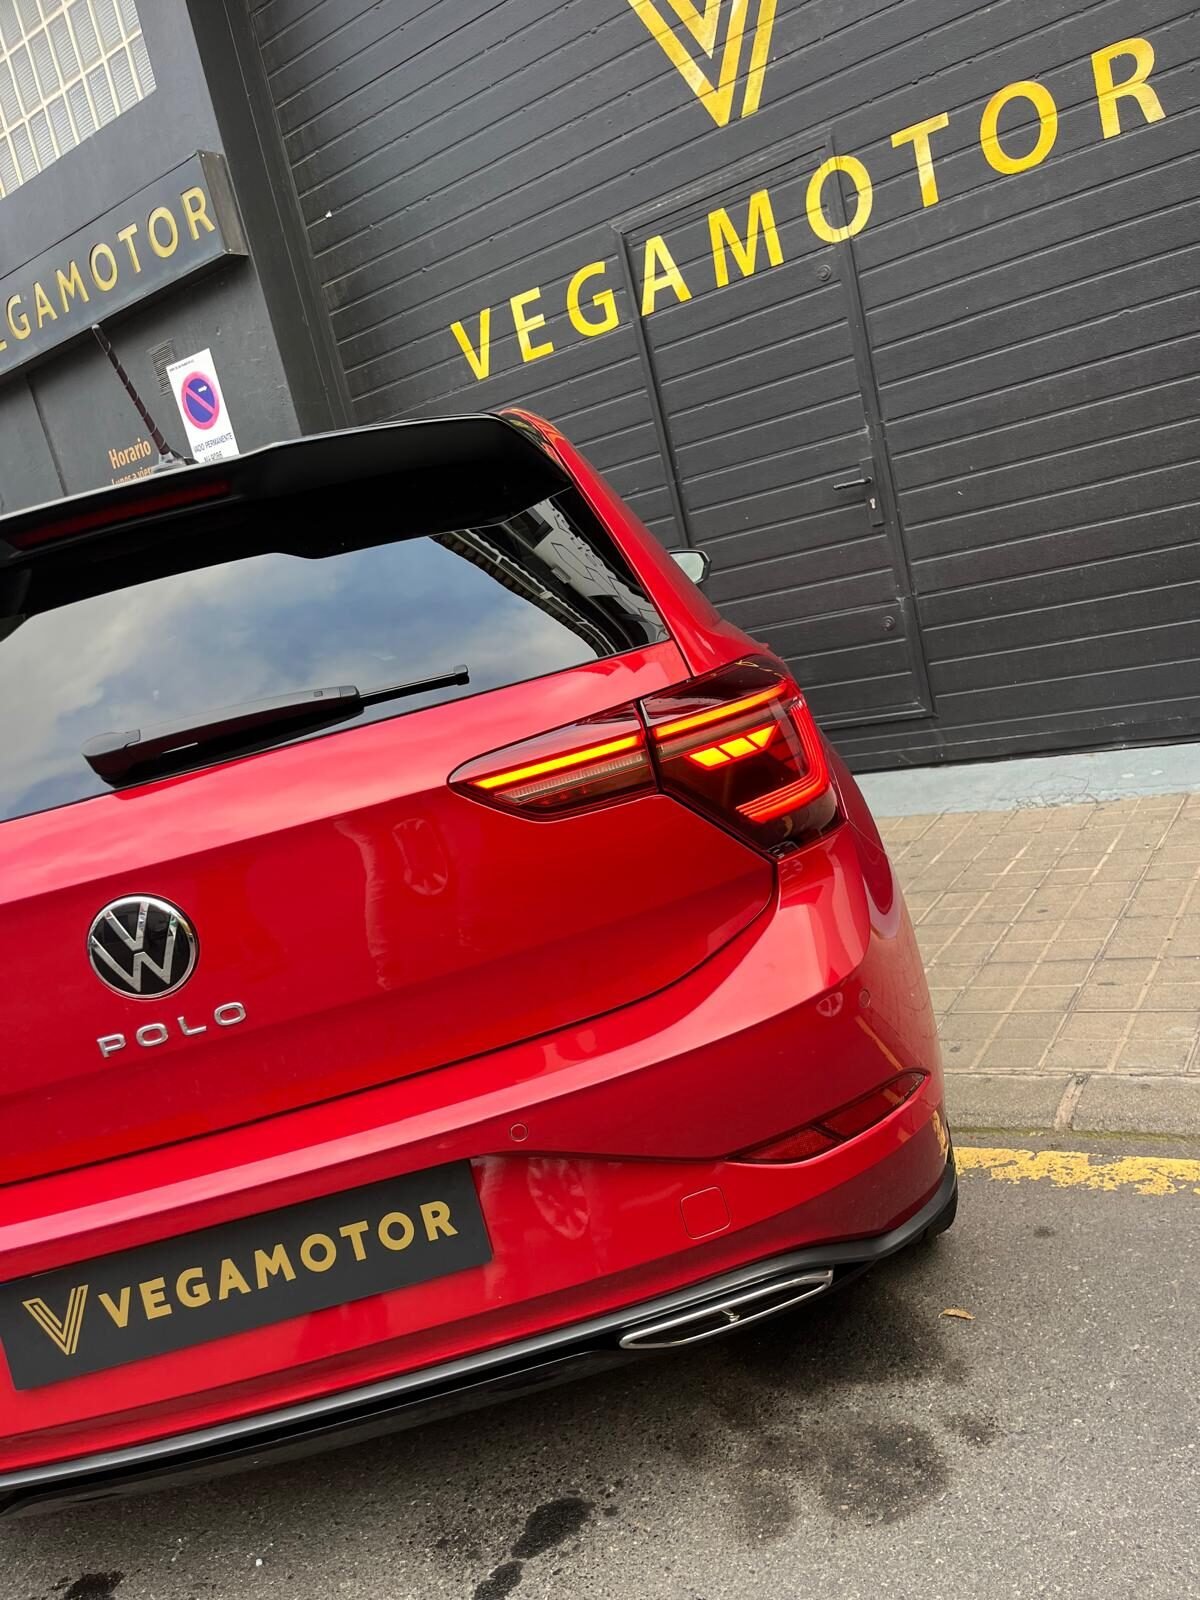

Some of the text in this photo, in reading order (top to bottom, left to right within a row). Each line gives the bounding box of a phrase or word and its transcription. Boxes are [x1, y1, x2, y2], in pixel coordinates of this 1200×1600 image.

[0, 186, 215, 351] GAMOTOR
[450, 37, 1166, 380] VEGAMOTOR
[109, 437, 152, 469] Horario
[97, 1002, 246, 1057] POLO
[98, 1201, 458, 1328] VEGAMOTOR
